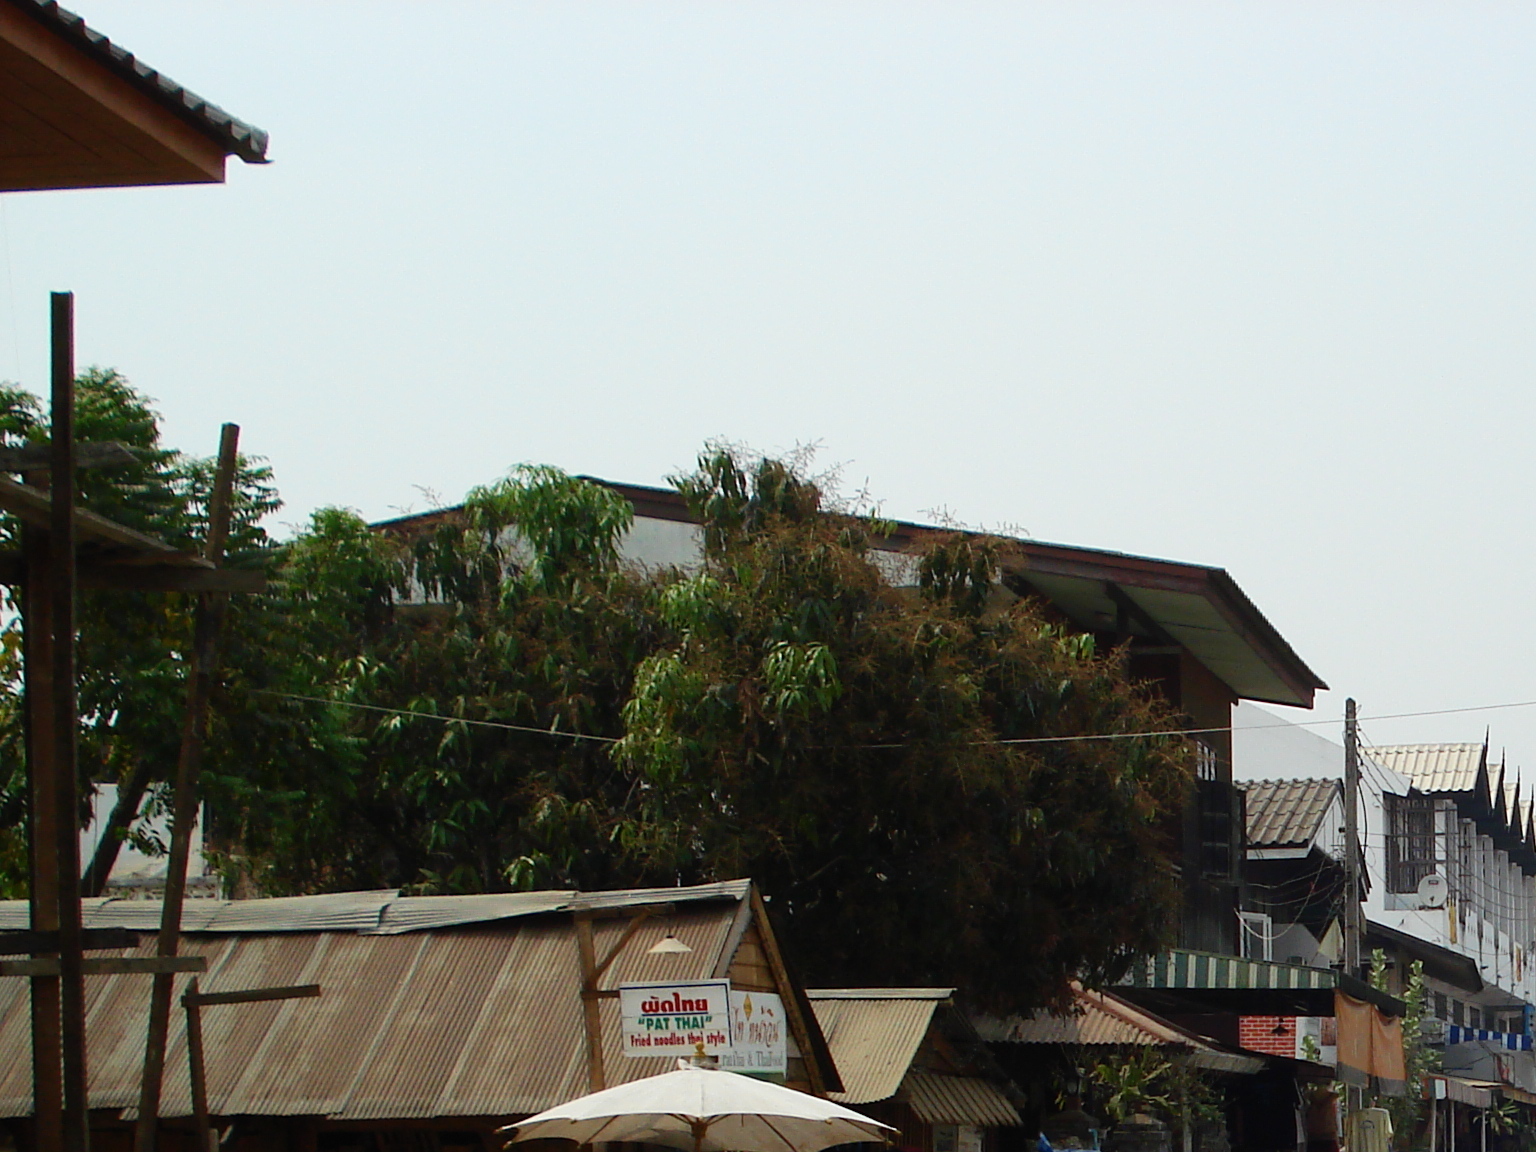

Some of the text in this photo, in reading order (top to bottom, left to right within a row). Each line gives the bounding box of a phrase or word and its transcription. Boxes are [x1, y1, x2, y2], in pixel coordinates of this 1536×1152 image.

[641, 992, 708, 1013] ผัดไทย
[631, 1034, 651, 1047] Fried
[654, 1033, 685, 1046] noodles
[707, 1030, 726, 1047] style
